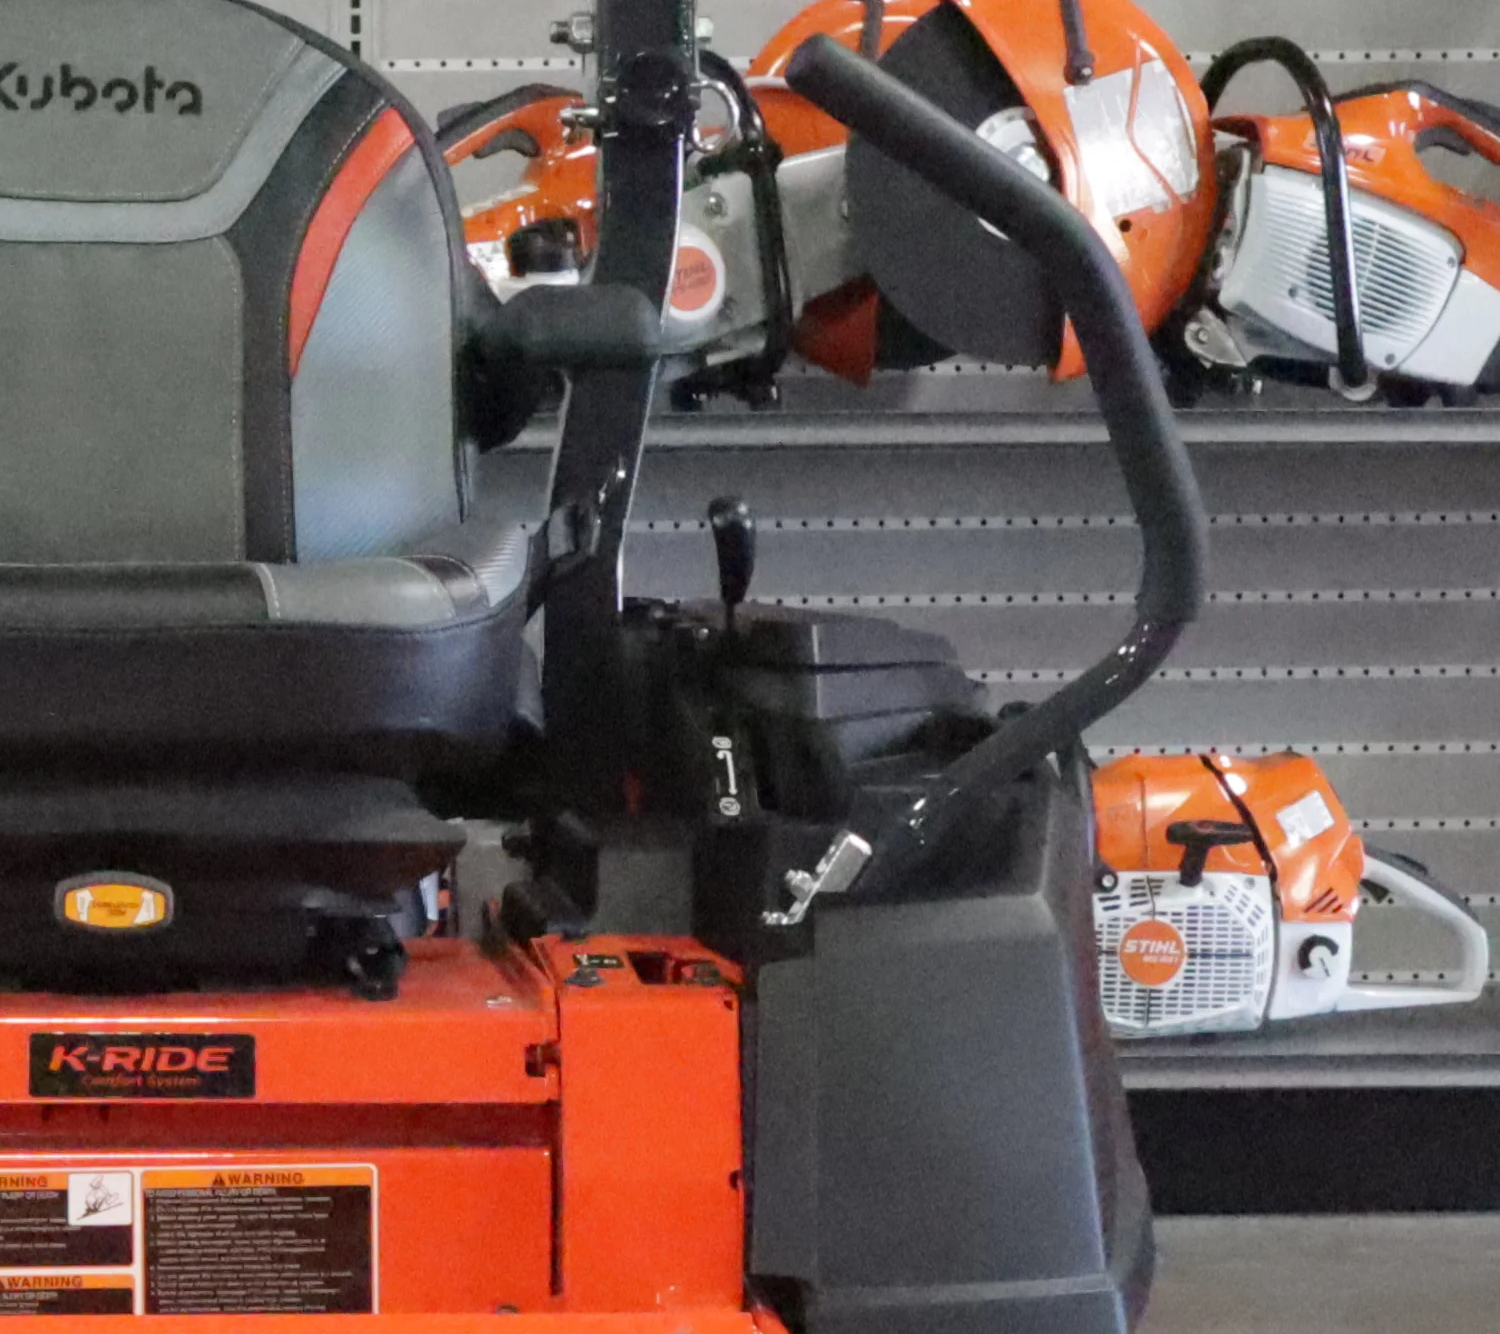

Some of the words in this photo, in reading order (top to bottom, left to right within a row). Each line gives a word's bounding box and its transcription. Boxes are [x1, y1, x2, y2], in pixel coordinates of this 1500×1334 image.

[1124, 939, 1180, 954] STIHL
[49, 1044, 235, 1074] K-RIDE
[227, 1172, 305, 1185] WARNING
[7, 1276, 84, 1288] WARNING
